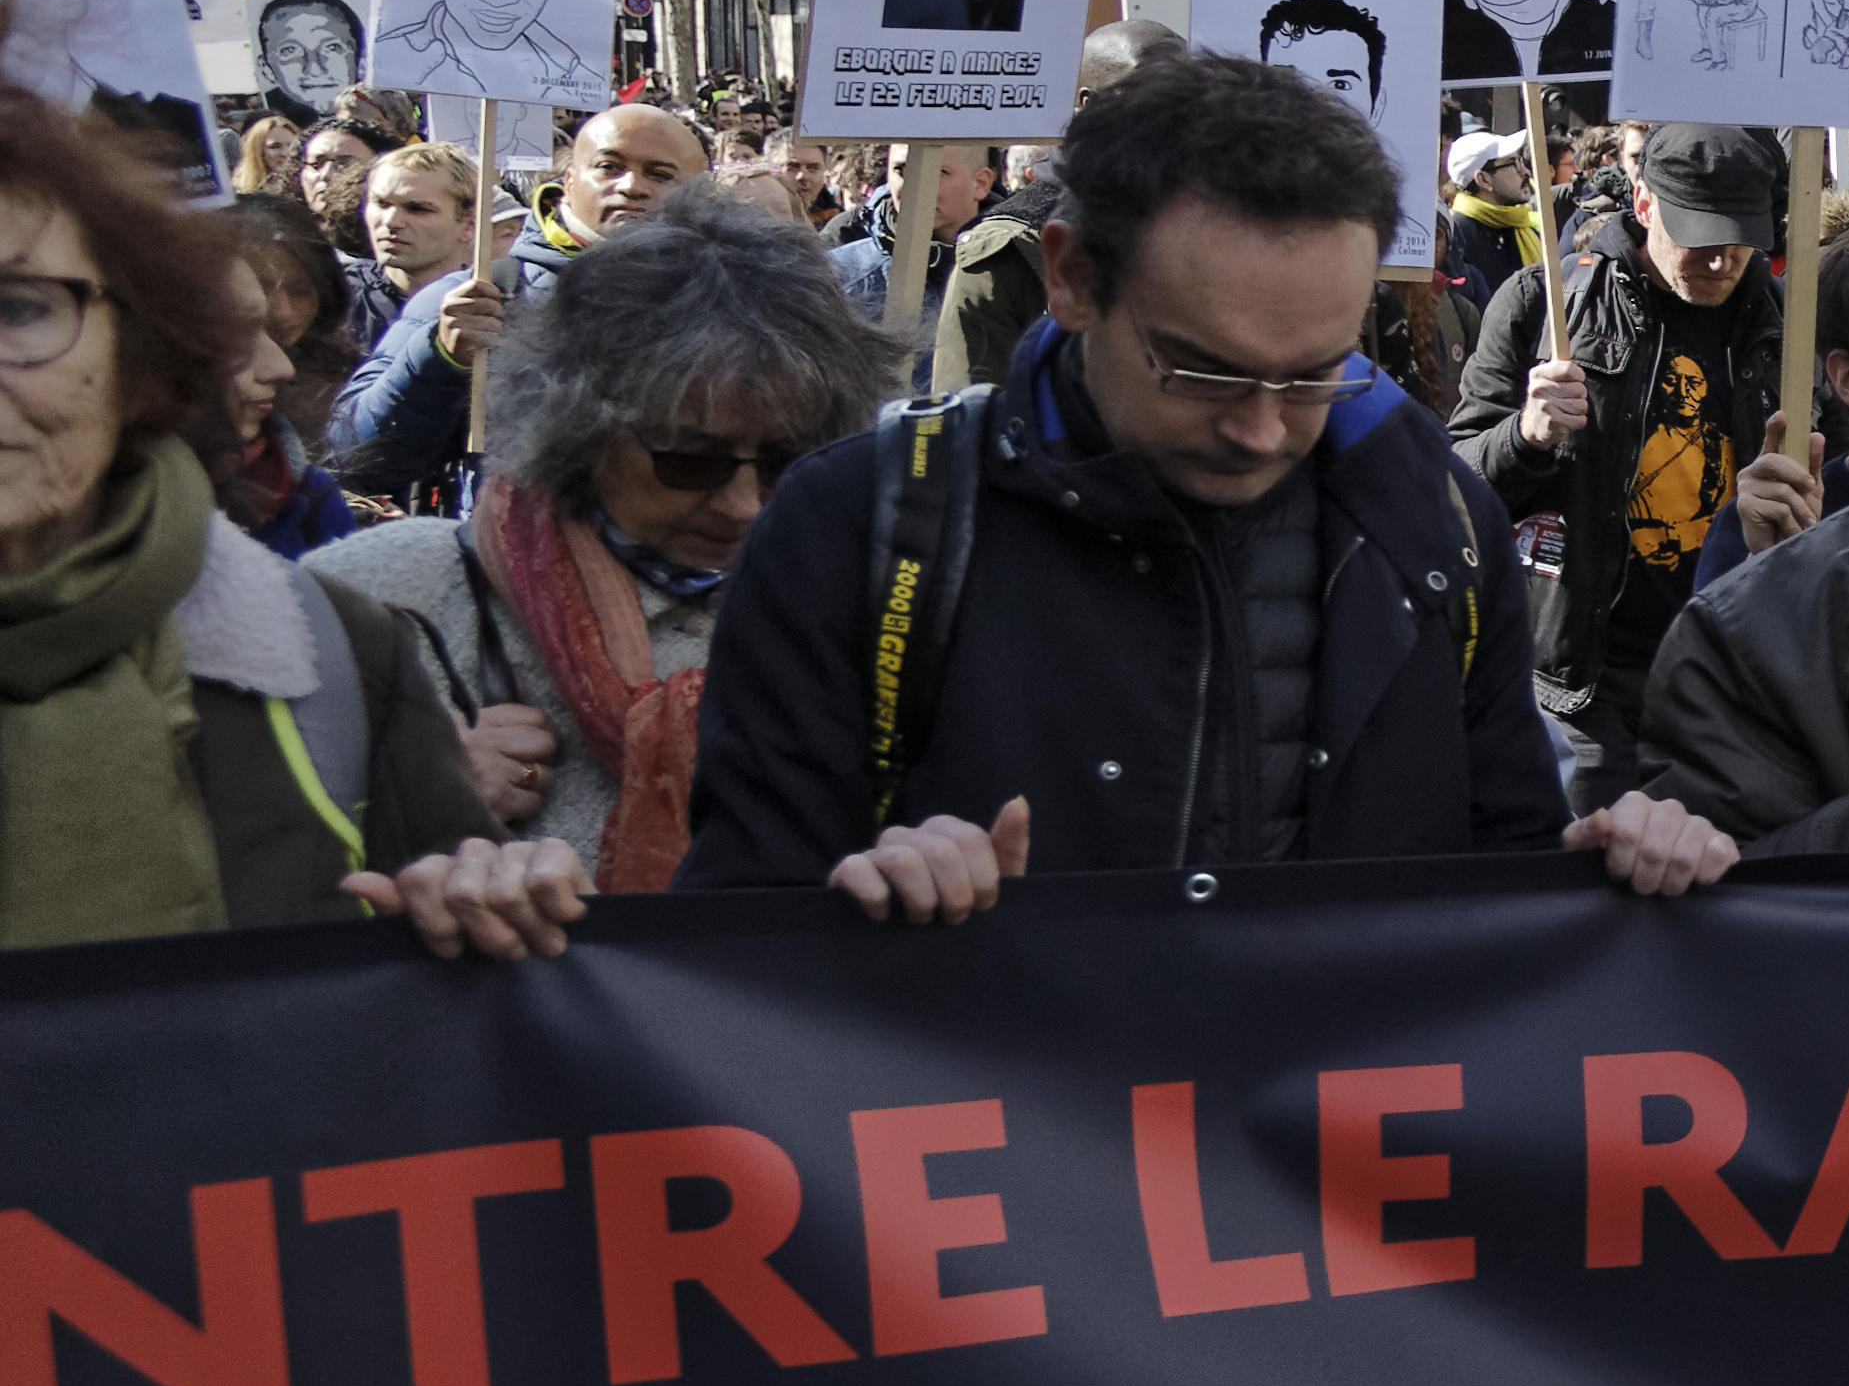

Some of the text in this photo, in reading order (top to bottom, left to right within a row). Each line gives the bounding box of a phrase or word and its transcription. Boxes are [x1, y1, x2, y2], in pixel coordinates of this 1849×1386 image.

[835, 81, 866, 108] LE
[870, 81, 901, 108] 22
[907, 83, 996, 110] FEVRIER
[1129, 1061, 1479, 1319] LE
